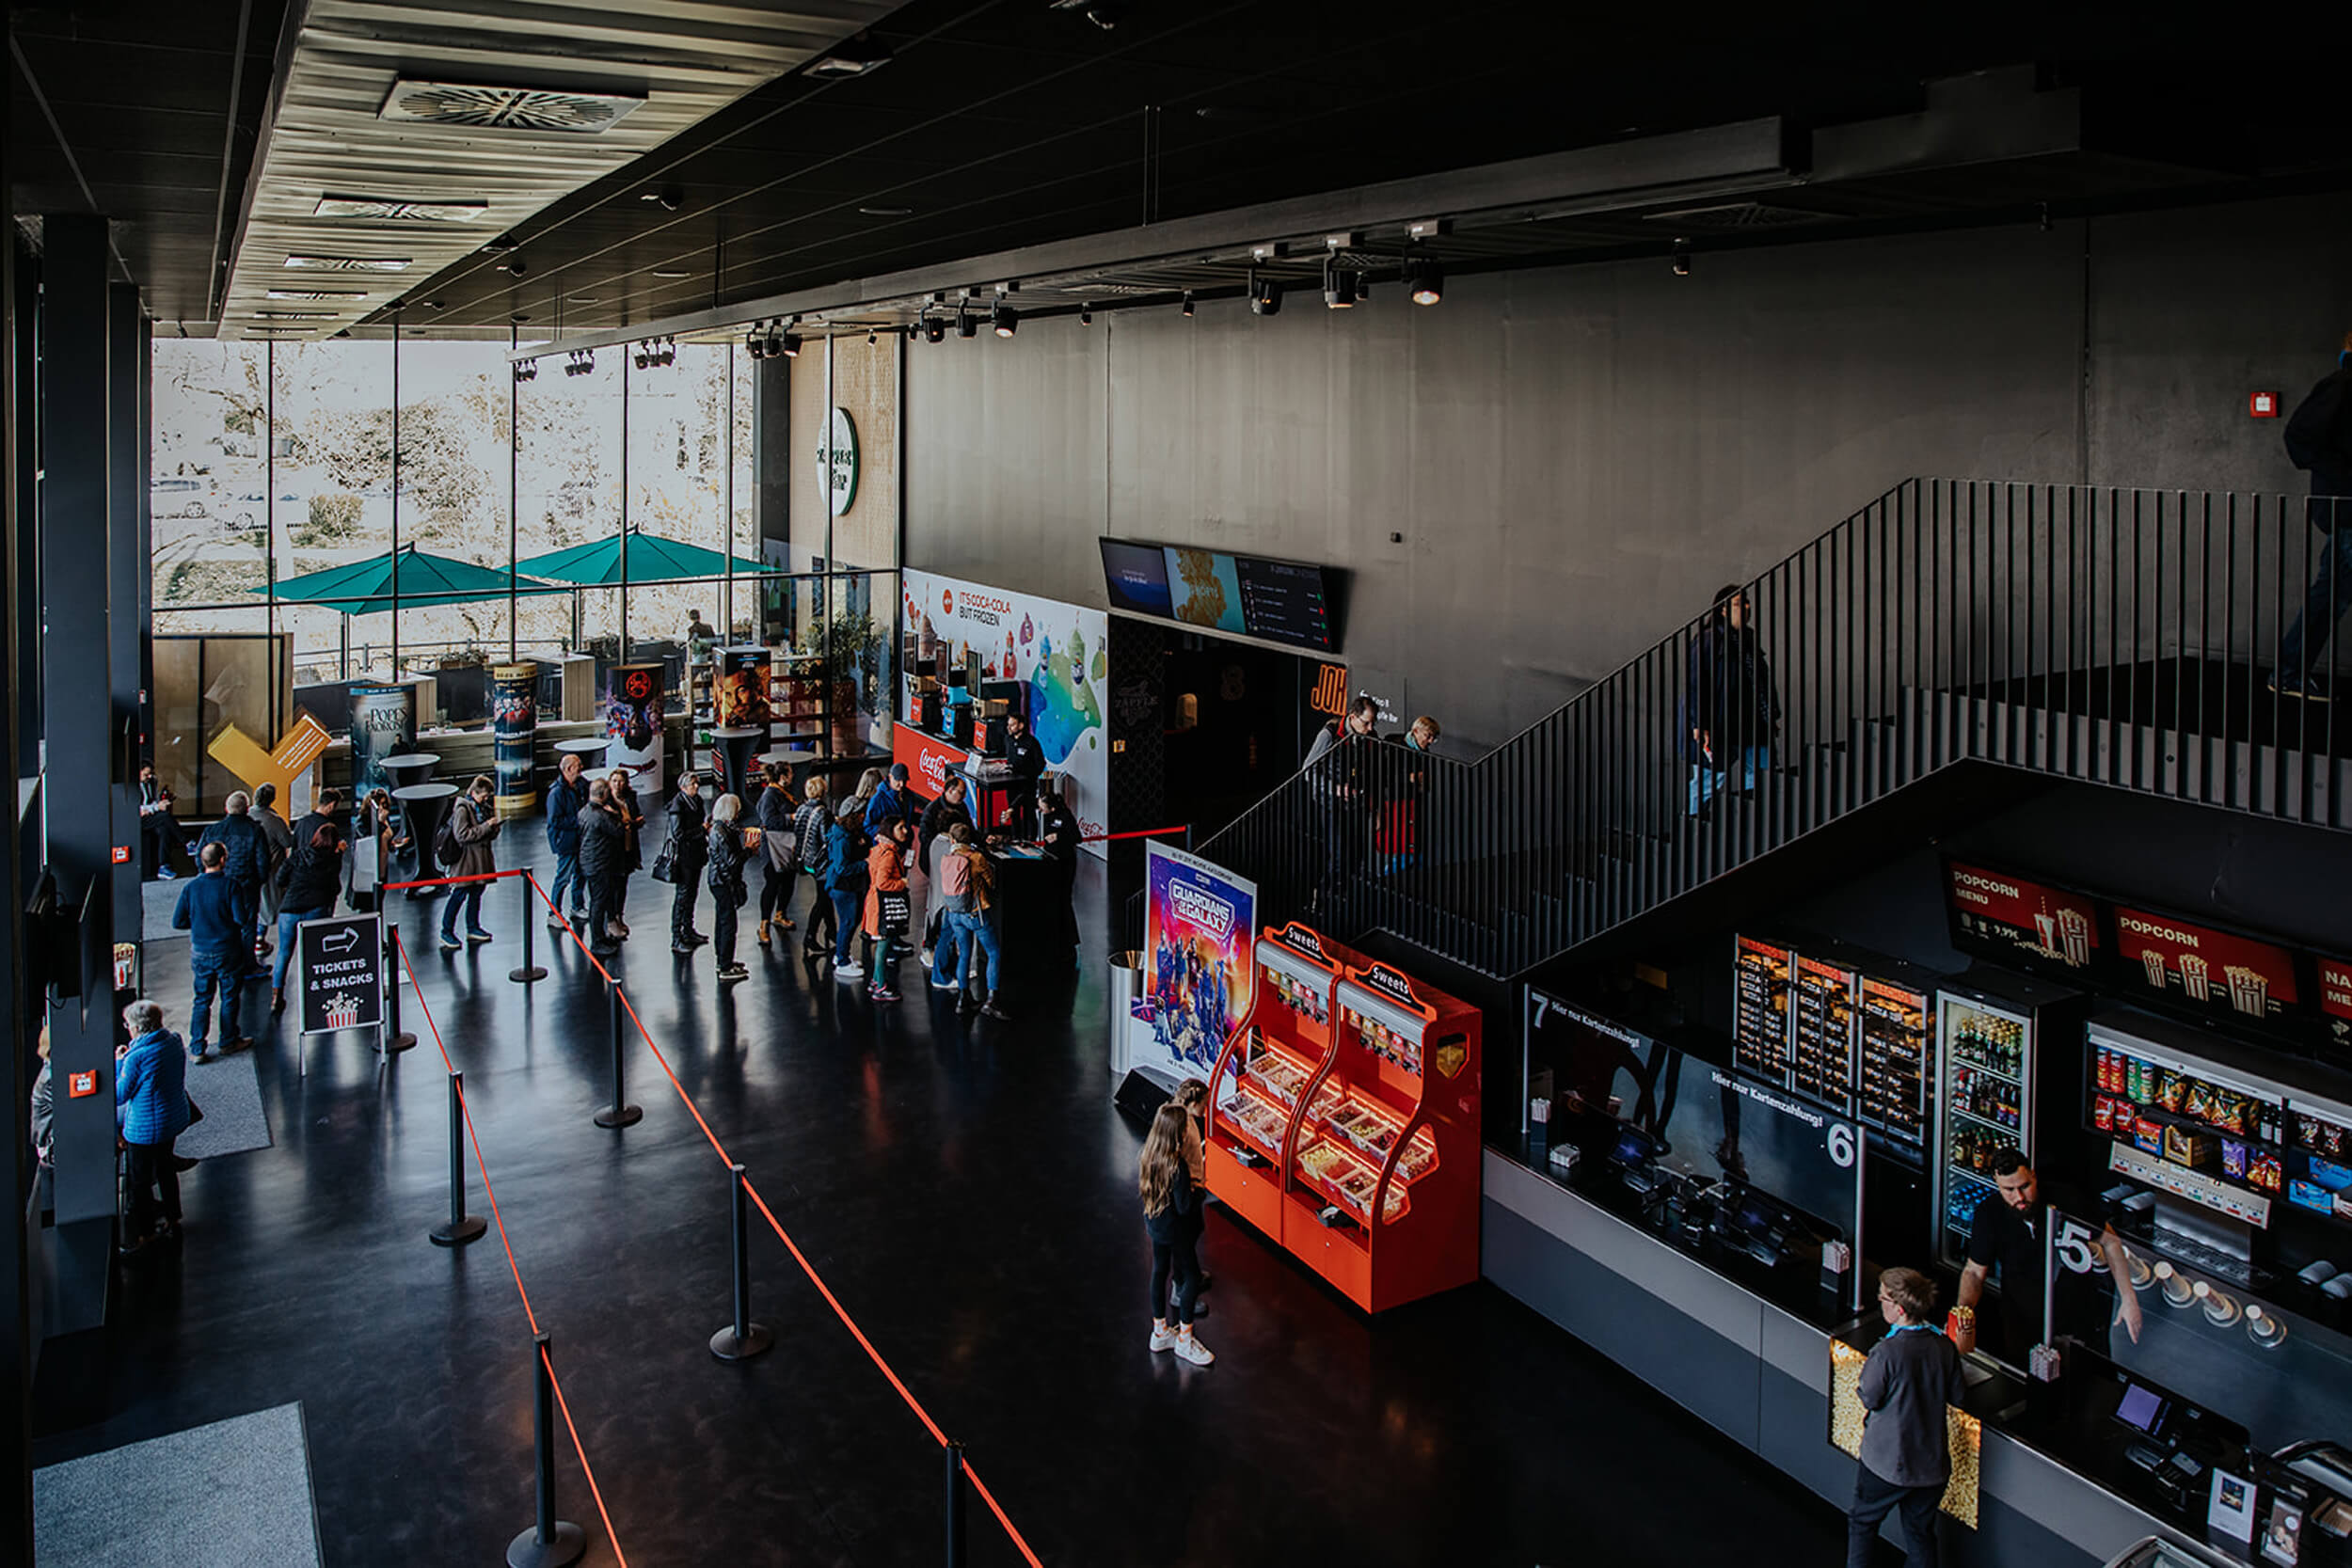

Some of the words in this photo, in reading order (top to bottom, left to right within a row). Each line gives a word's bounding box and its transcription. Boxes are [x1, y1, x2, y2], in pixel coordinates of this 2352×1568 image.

[960, 605, 973, 620] BUT
[973, 609, 1000, 626] FROZEN
[971, 594, 1011, 613] COCA-COLA
[1953, 871, 2019, 898] POPCORN
[1955, 888, 1989, 905] MENU
[1173, 884, 1230, 920] GUARDIANS
[1288, 926, 1320, 952] Sweets
[2120, 916, 2200, 947] POPCORN
[311, 958, 367, 975] TICKETS
[1373, 965, 1409, 995] Sweets
[310, 980, 321, 992] &
[322, 973, 374, 990] SNACKS
[1531, 990, 1549, 1030] 7
[1551, 1000, 1568, 1017] Hier
[1567, 1008, 1581, 1022] nur
[1581, 1014, 1641, 1049] Kartenzahlung!
[1710, 1070, 1732, 1088] Hier
[1732, 1081, 1749, 1096] nur
[1749, 1086, 1824, 1129] Kartenzahlung!
[1827, 1122, 1855, 1168] 6
[2054, 1220, 2093, 1275] 5
